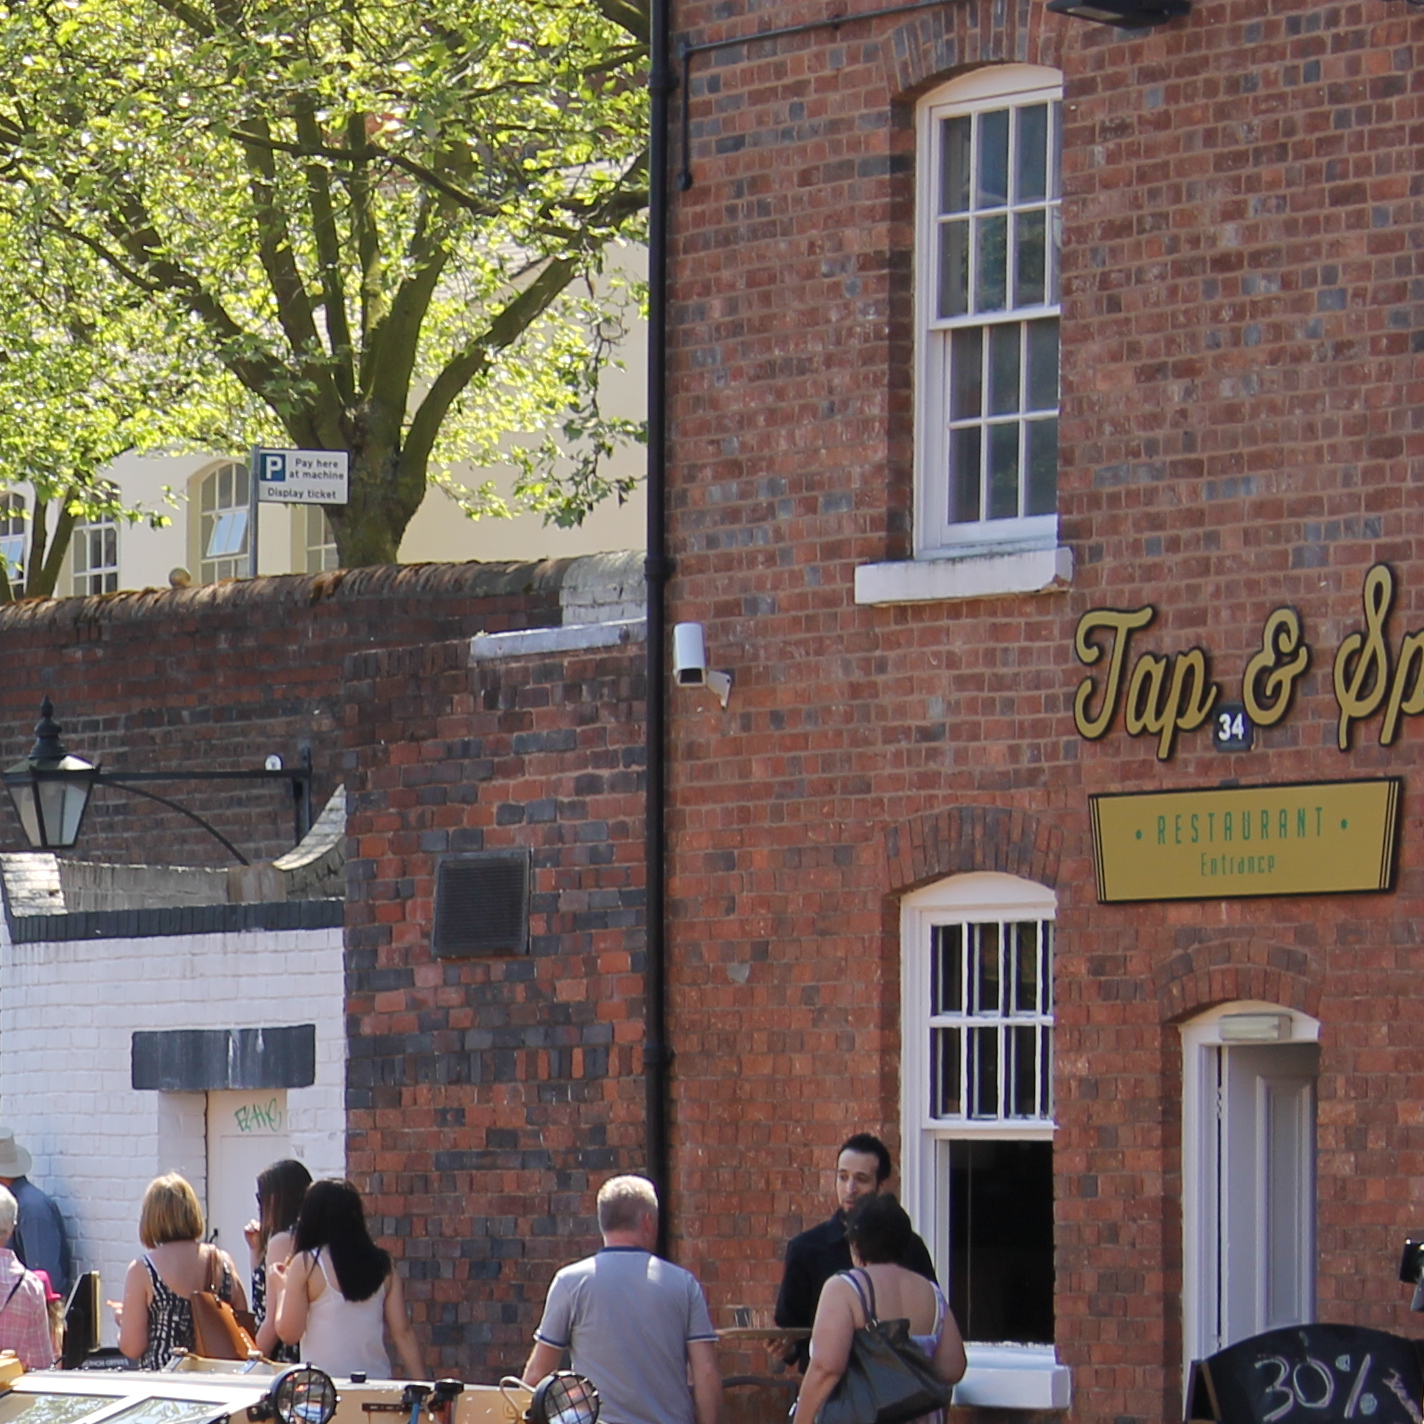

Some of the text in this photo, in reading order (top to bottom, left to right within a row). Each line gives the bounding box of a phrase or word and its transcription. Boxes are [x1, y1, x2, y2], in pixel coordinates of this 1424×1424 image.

[265, 455, 283, 479] P
[289, 470, 344, 480] at machine
[295, 458, 339, 469] Pay here
[267, 487, 336, 499] Display ticket
[1074, 602, 1218, 761] Tap
[1242, 605, 1309, 727] &
[1218, 713, 1245, 741] 34
[1156, 807, 1324, 845] RESTAURANT
[1201, 852, 1276, 877] Entrance
[1254, 1353, 1378, 1422] 30%
